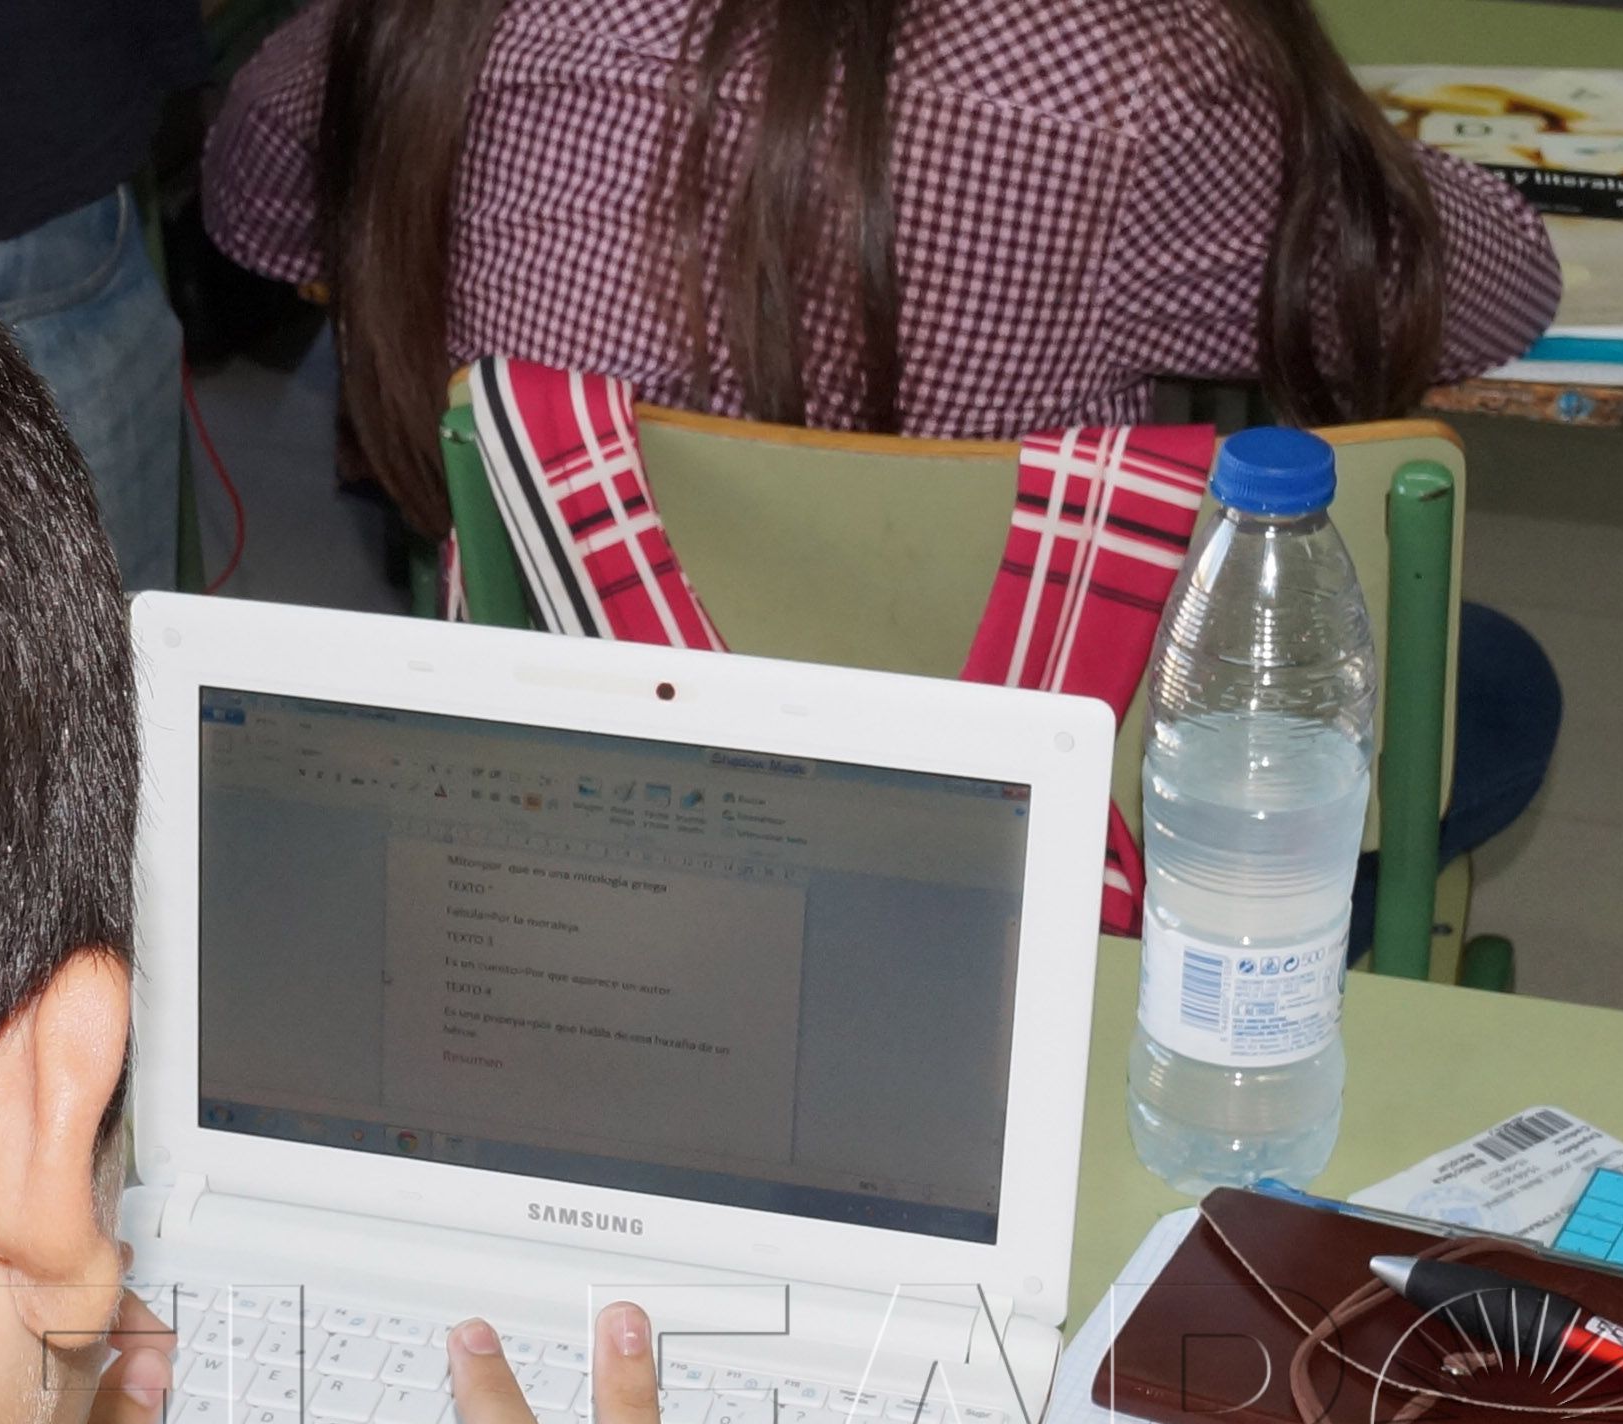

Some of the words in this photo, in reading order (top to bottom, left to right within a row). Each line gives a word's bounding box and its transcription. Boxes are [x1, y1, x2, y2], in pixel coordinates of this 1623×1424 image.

[508, 863, 529, 875] que
[533, 867, 546, 877] es
[548, 870, 570, 880] una
[447, 879, 485, 895] TEXTO
[513, 914, 524, 925] la
[446, 930, 484, 946] TEXTO
[460, 961, 475, 970] un
[548, 971, 568, 984] que
[571, 975, 619, 990] aparece
[622, 981, 636, 991] un
[639, 984, 671, 996] autor
[445, 980, 483, 996] TEXTO
[715, 1045, 730, 1055] un
[442, 1049, 503, 1070] Resumen
[527, 1202, 644, 1236] SAMSUNG
[206, 1332, 218, 1343] 2
[269, 1342, 282, 1354] 3
[329, 1352, 341, 1363] 4
[204, 1358, 223, 1371] W
[394, 1363, 406, 1374] 5
[267, 1369, 282, 1381] E
[330, 1380, 345, 1392] R
[283, 1388, 298, 1400] €
[396, 1390, 410, 1402] T
[196, 1400, 210, 1412] S
[260, 1411, 274, 1423] D
[964, 1408, 992, 1419] Supr
